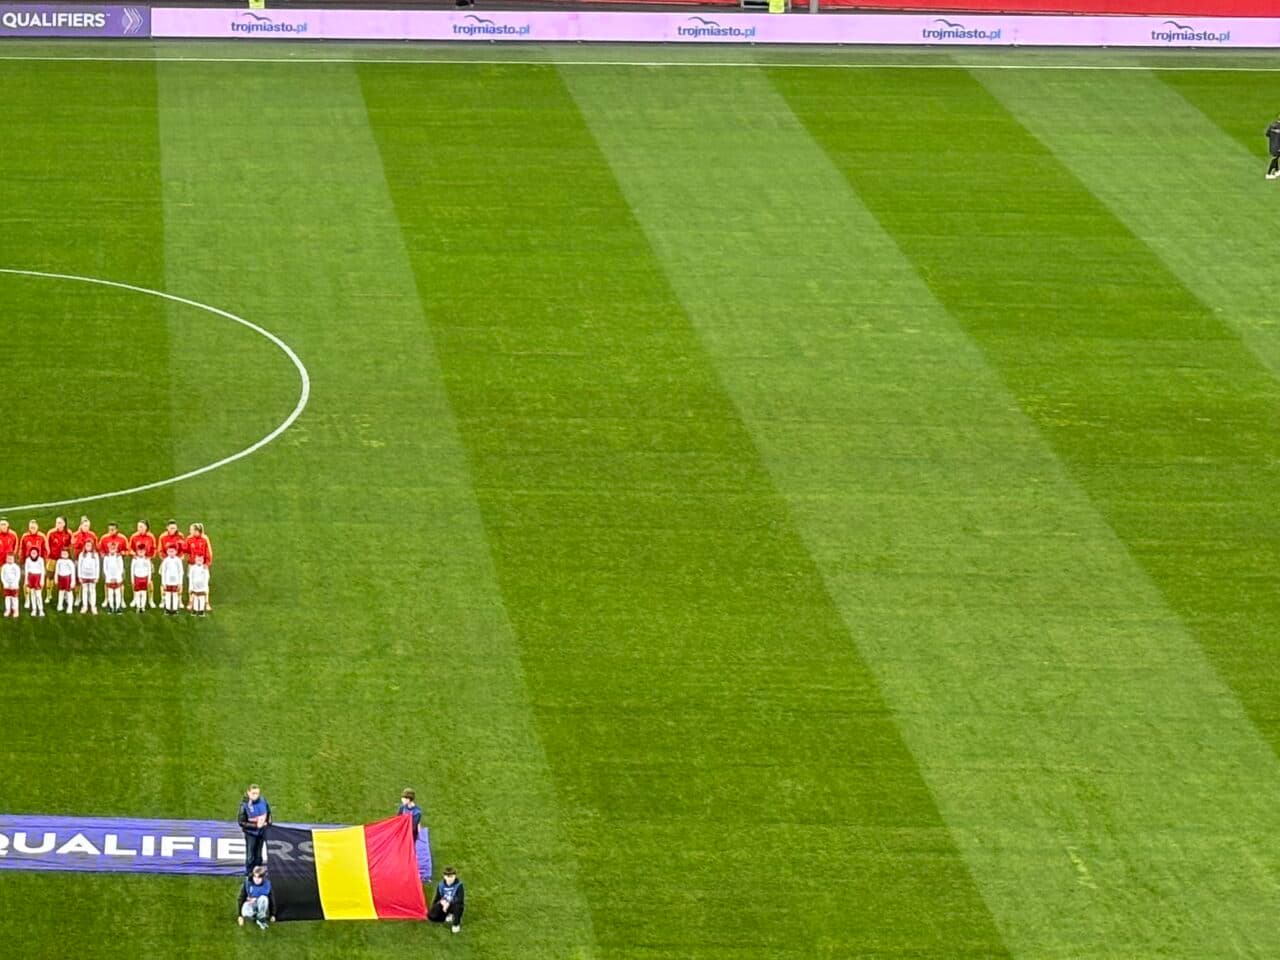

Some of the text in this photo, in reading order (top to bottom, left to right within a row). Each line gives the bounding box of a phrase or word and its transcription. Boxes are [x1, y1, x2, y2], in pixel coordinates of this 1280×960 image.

[2, 13, 106, 28] QUALIFIERS
[231, 22, 307, 33] trojmiasto.pl
[453, 24, 530, 35] trojmiasto.pl
[678, 26, 756, 37] trojmiasto.pl
[922, 28, 1001, 39] trojmiasto.pl
[1151, 30, 1230, 41] trojmiasto.pl
